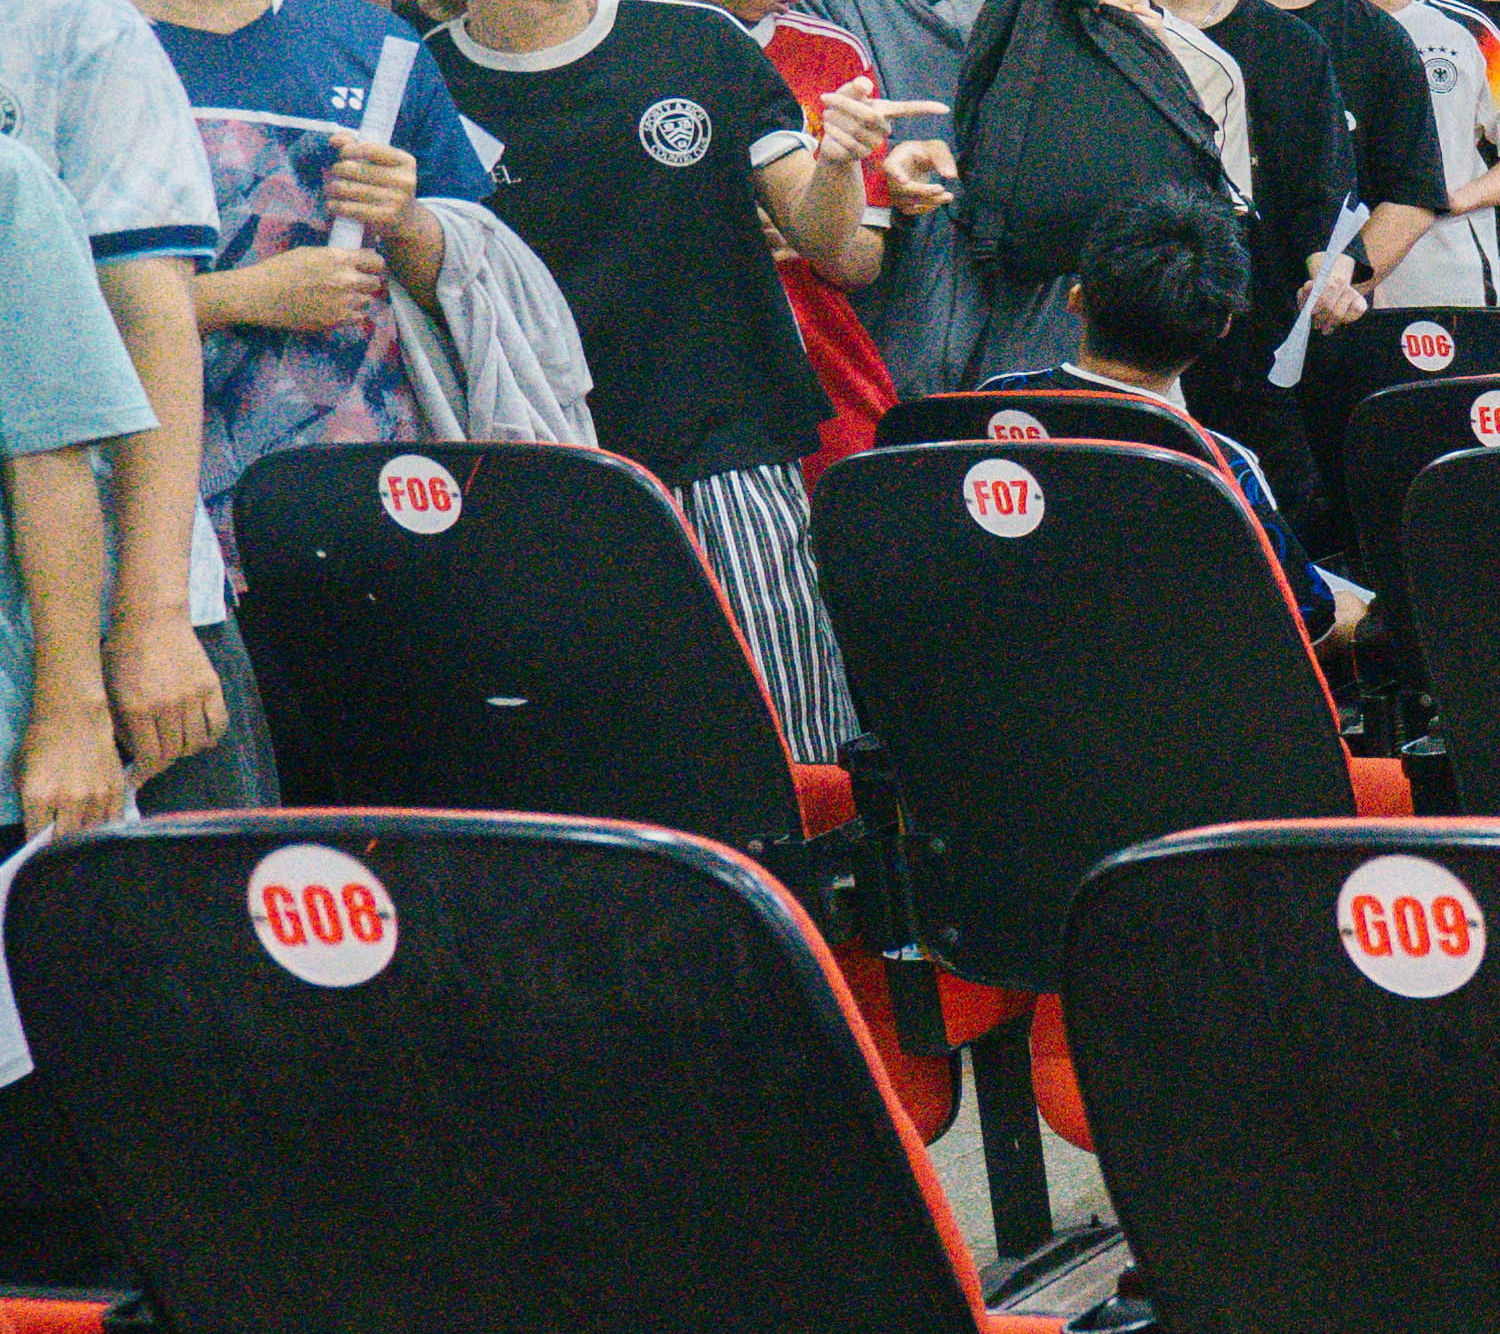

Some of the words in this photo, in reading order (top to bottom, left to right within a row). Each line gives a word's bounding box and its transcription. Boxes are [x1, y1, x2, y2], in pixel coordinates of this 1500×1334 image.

[1406, 335, 1450, 357] D06
[388, 477, 451, 511] F06
[974, 480, 1028, 515] F07
[262, 883, 383, 946] G08
[1352, 894, 1471, 957] G09
